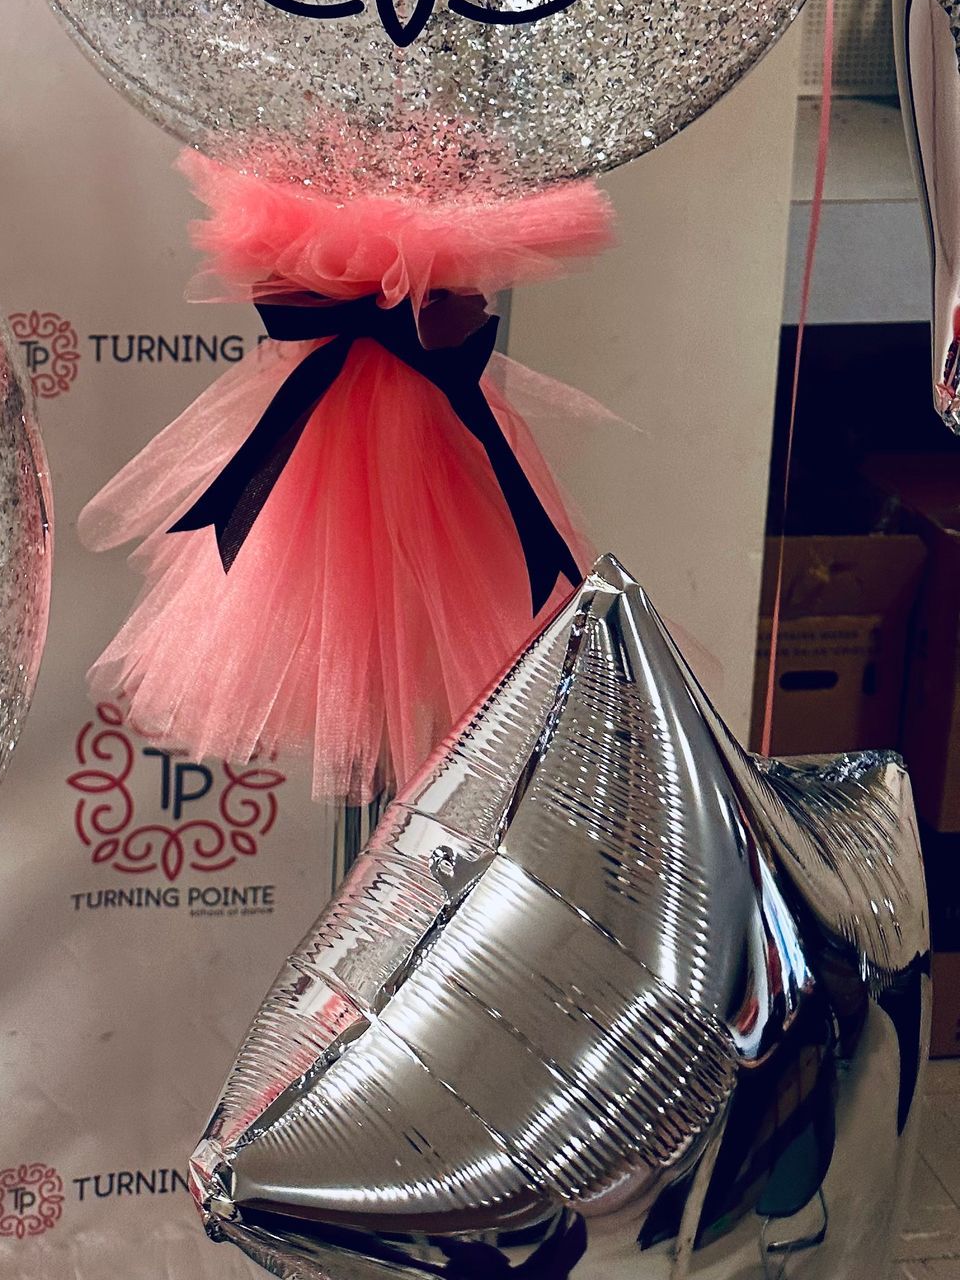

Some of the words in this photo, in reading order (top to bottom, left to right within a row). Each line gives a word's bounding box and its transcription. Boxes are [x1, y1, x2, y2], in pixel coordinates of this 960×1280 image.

[88, 334, 244, 363] TURNING
[71, 887, 180, 911] TURNING
[188, 885, 275, 907] POINTE
